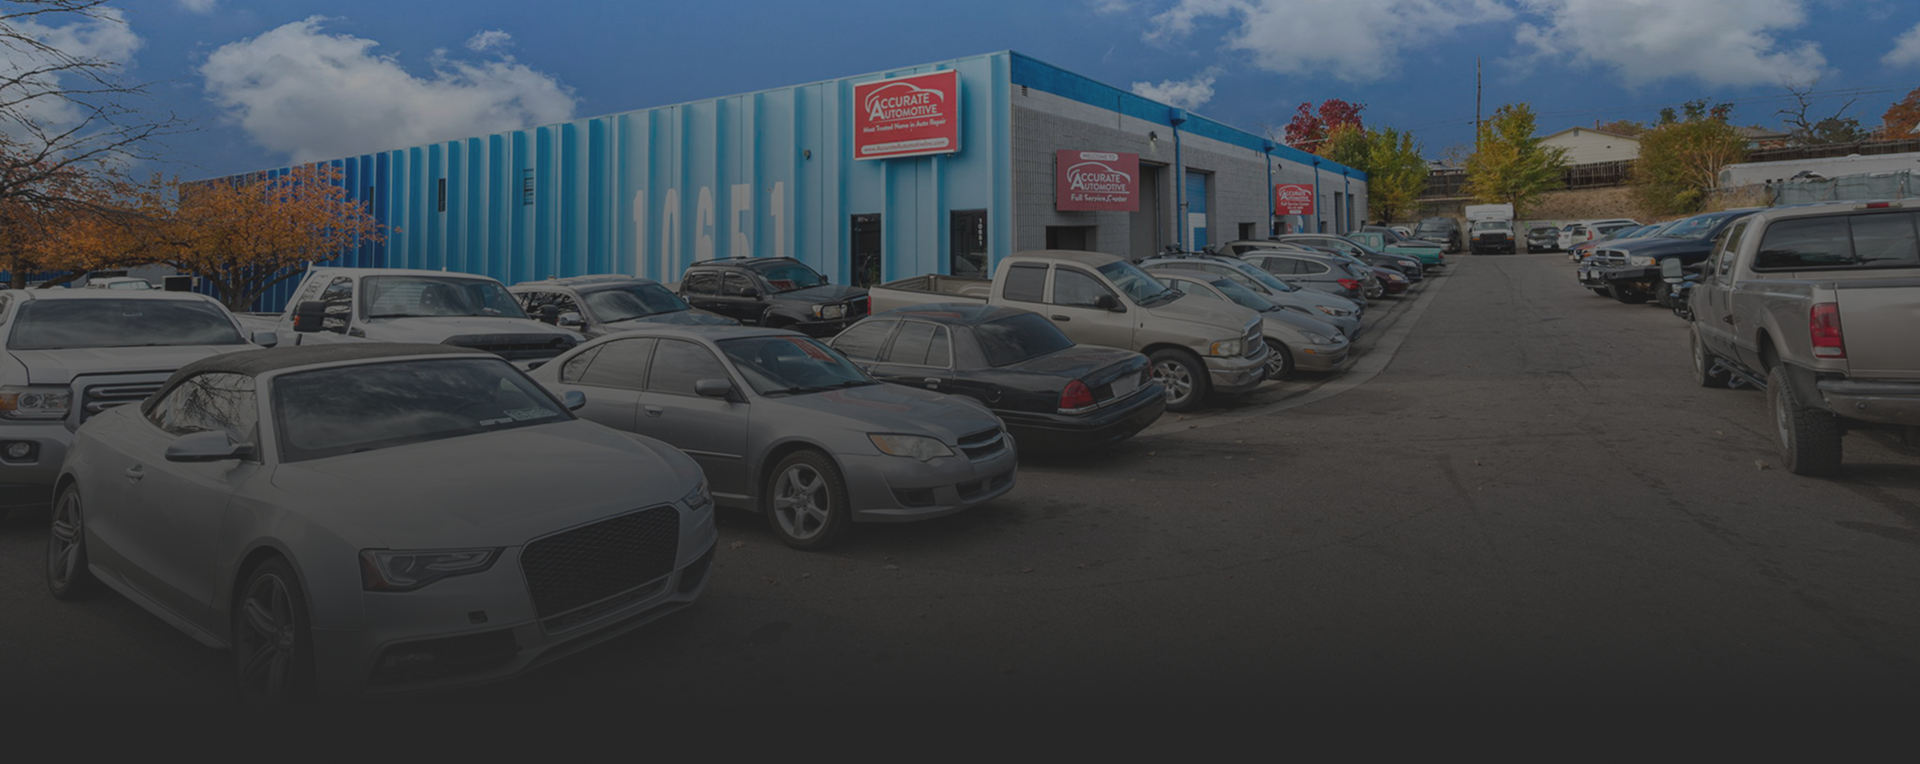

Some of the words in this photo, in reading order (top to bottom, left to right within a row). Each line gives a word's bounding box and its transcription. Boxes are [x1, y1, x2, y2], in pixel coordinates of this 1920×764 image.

[869, 93, 930, 117] ACCURATE
[869, 103, 937, 121] AUTOMOTIVE
[929, 118, 946, 127] Repair
[1070, 172, 1120, 186] ACCURATE
[1070, 181, 1126, 191] AUTOMOTIVE
[1084, 194, 1106, 202] Service
[633, 181, 784, 284] 10651
